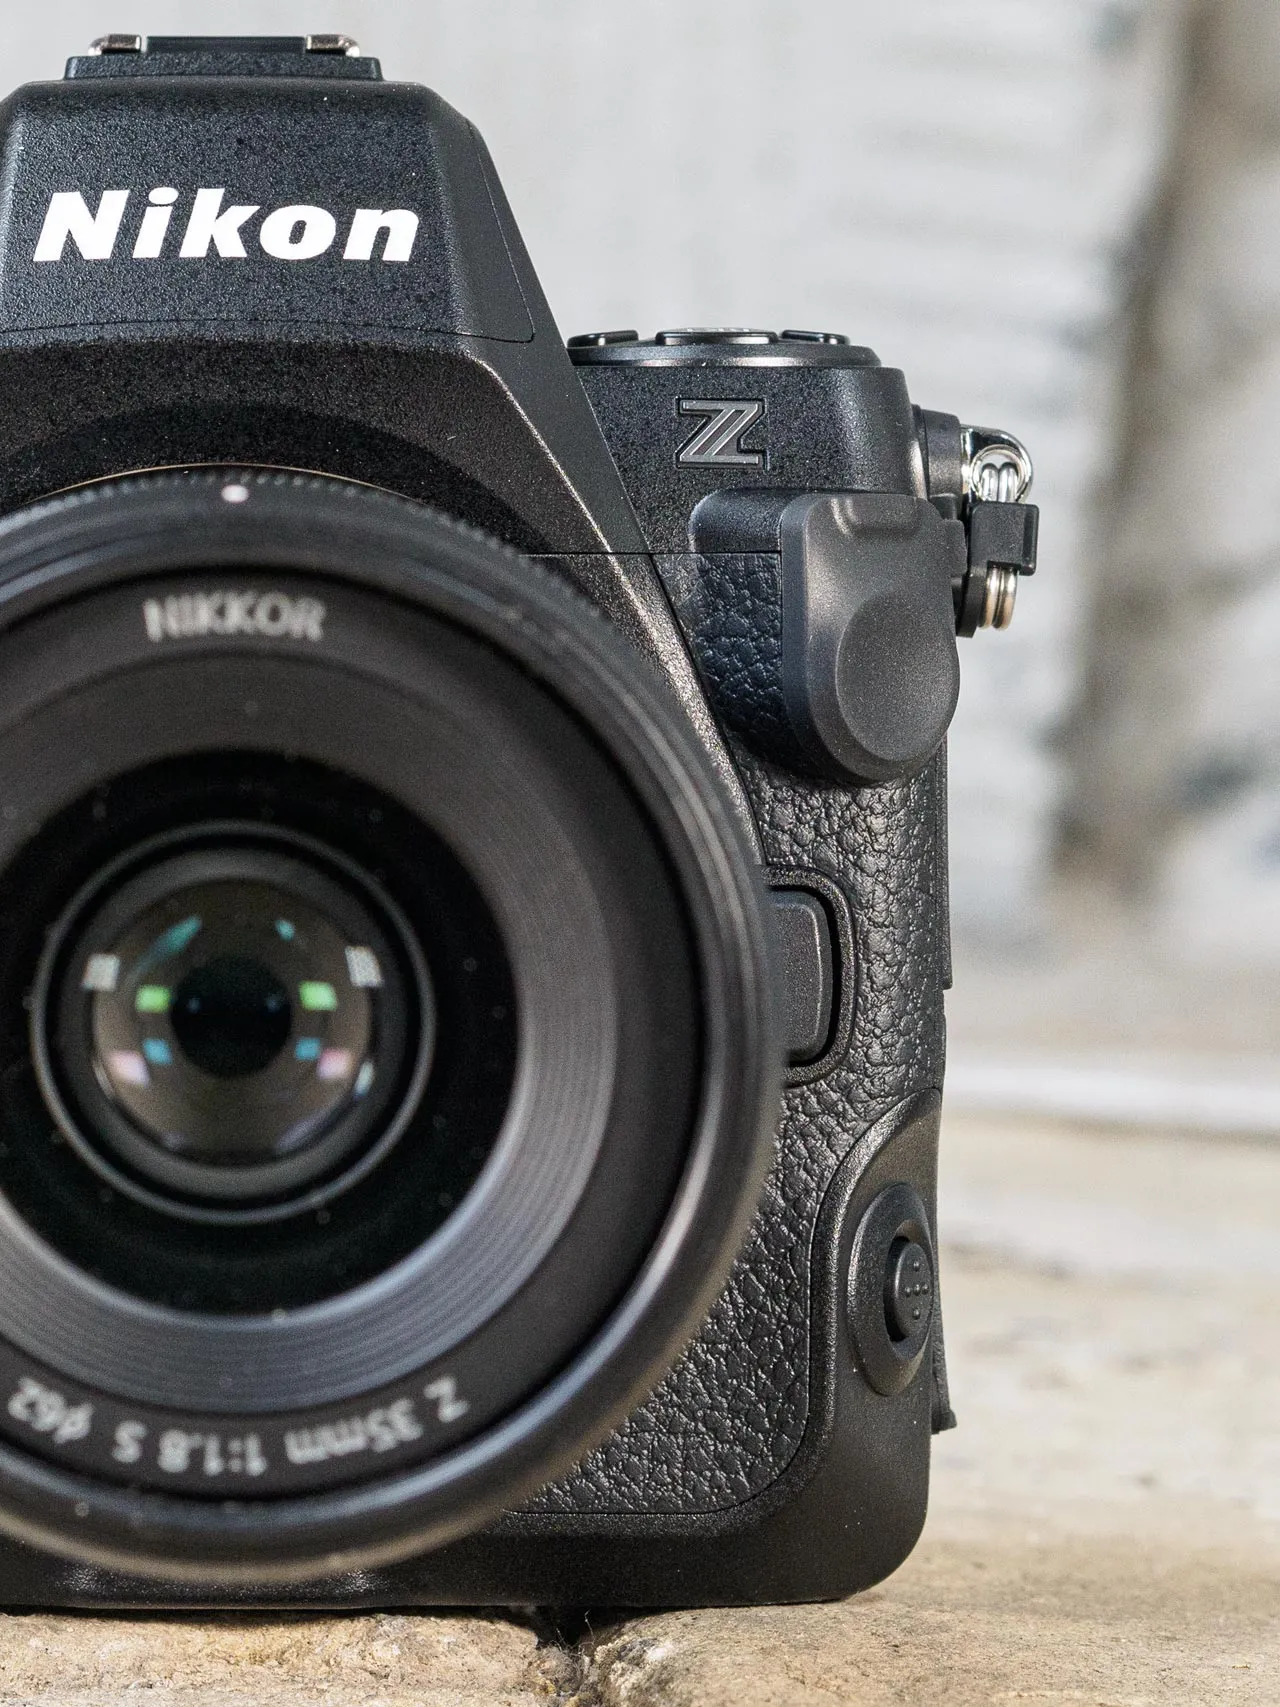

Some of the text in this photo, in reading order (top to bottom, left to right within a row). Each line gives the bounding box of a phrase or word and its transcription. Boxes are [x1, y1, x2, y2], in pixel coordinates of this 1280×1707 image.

[33, 186, 419, 262] Nikon
[677, 398, 764, 466] Z
[143, 592, 326, 641] NIKKOR
[424, 1376, 468, 1423] Z
[113, 1420, 147, 1463] S
[157, 1429, 265, 1476] 1:1.8
[284, 1399, 422, 1463] 35mm
